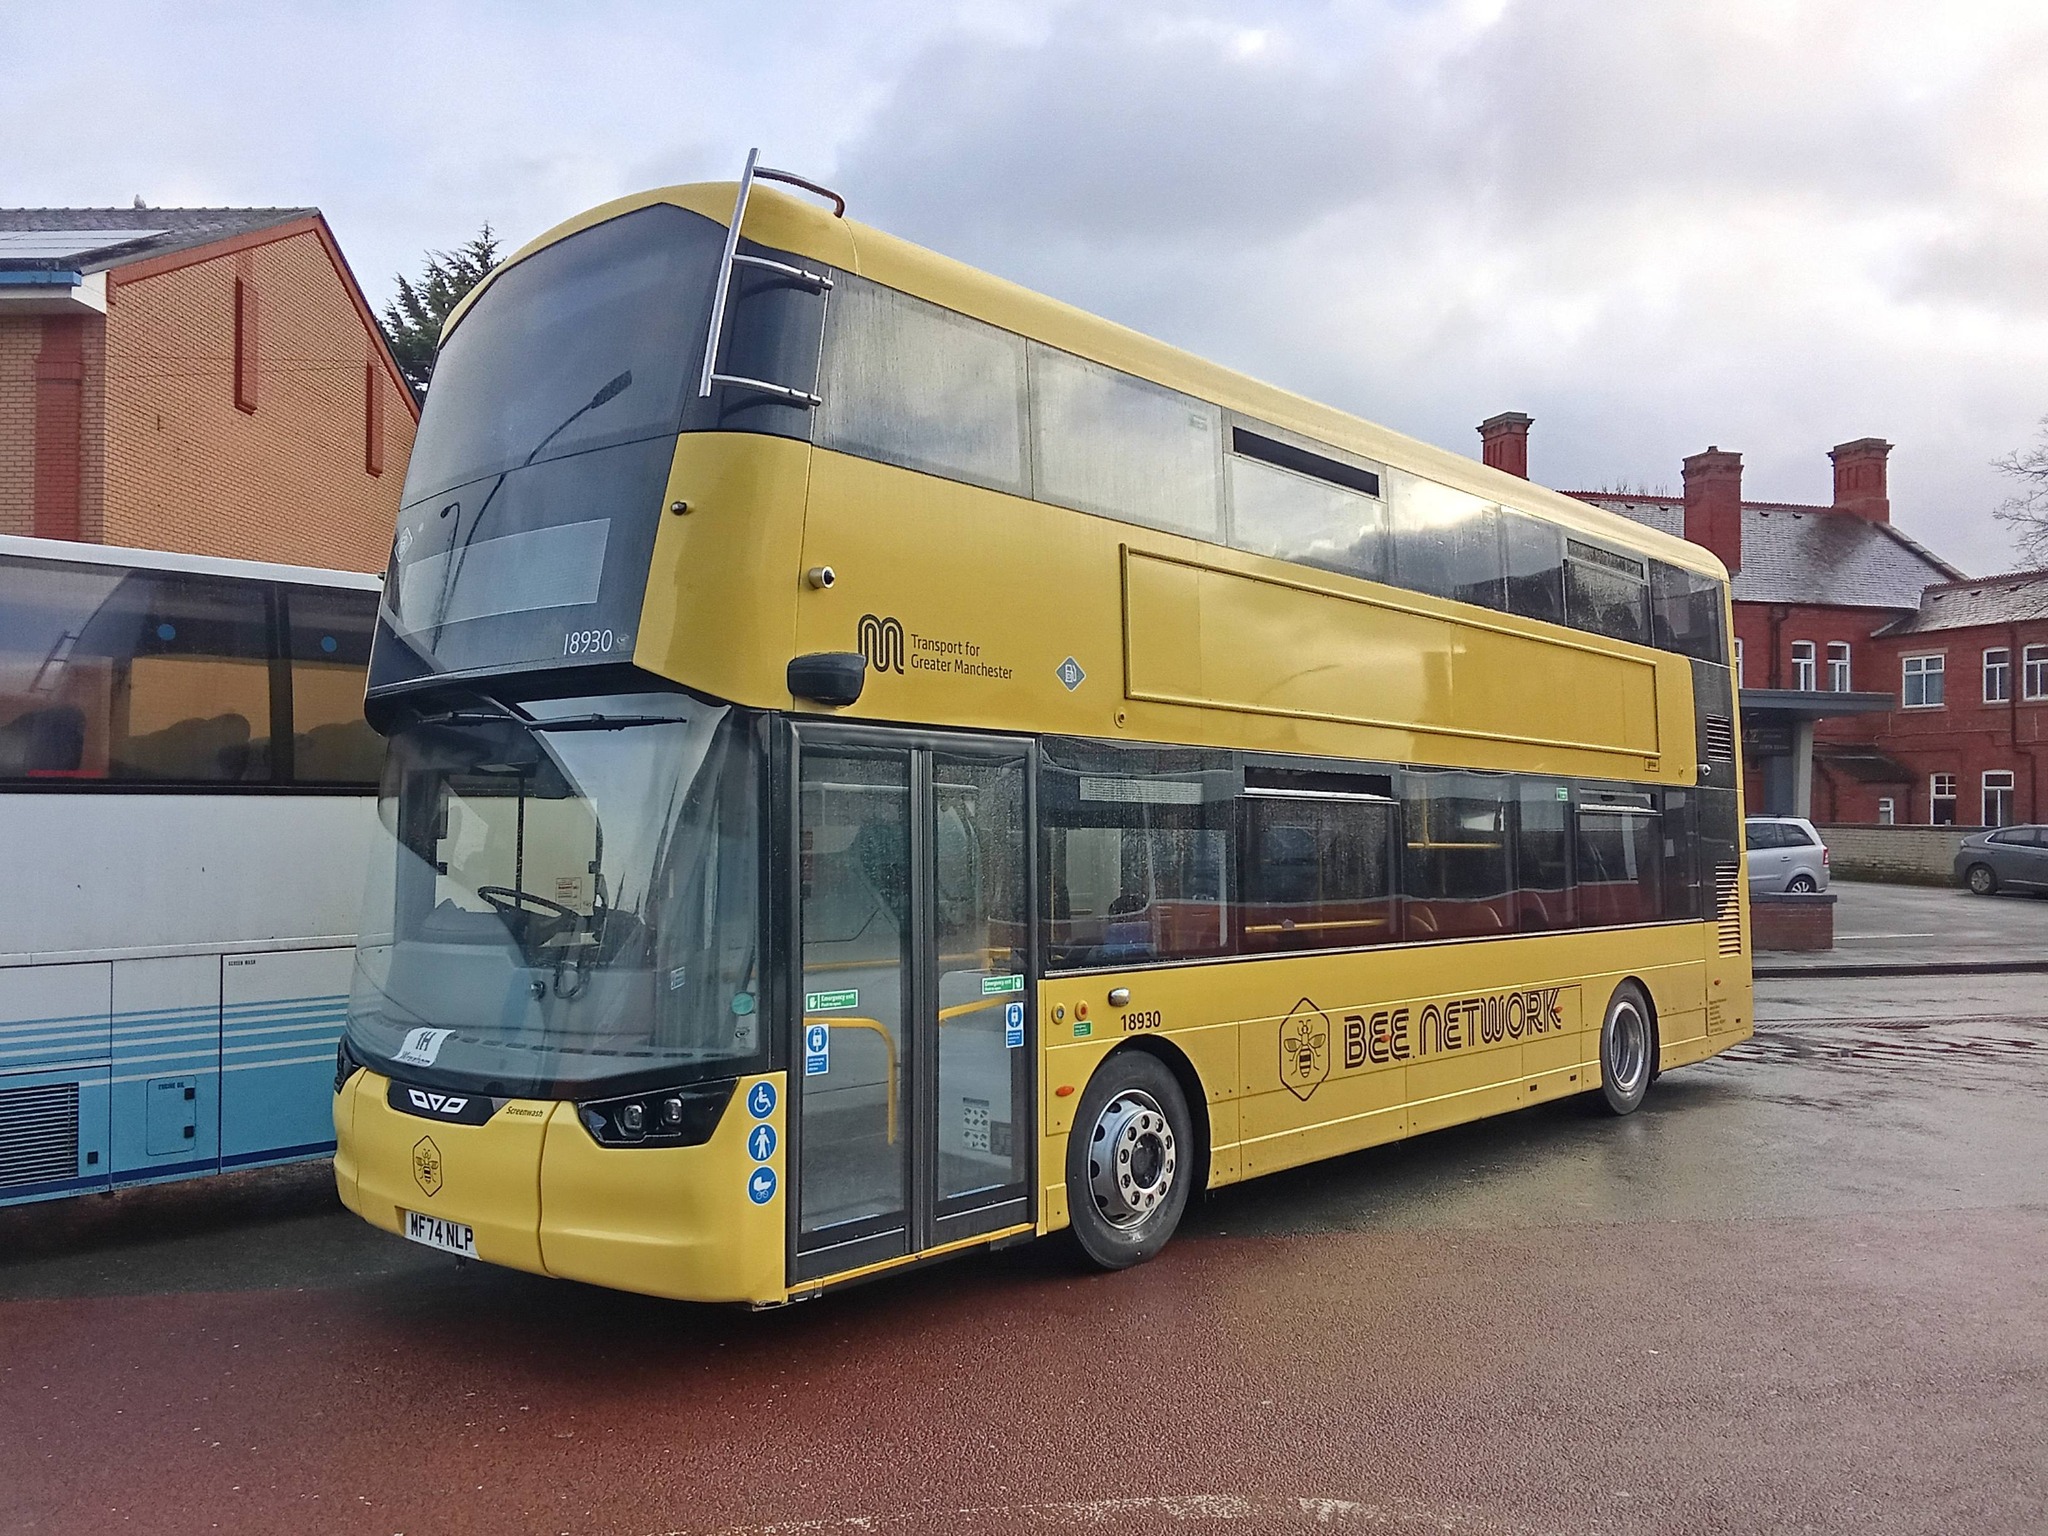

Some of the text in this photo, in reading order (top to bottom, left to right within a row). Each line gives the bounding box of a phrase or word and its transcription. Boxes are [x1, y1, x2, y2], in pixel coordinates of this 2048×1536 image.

[563, 629, 613, 656] 18930
[911, 633, 980, 657] Transport for
[911, 653, 1013, 680] Greater Manchester
[821, 994, 846, 1002] Emergency
[1120, 1010, 1161, 1031] 18930
[1344, 988, 1562, 1069] BEE NETWORK
[415, 1031, 437, 1051] 1H
[506, 1105, 544, 1118] Screenwash
[411, 1213, 474, 1251] MF74 NLP
